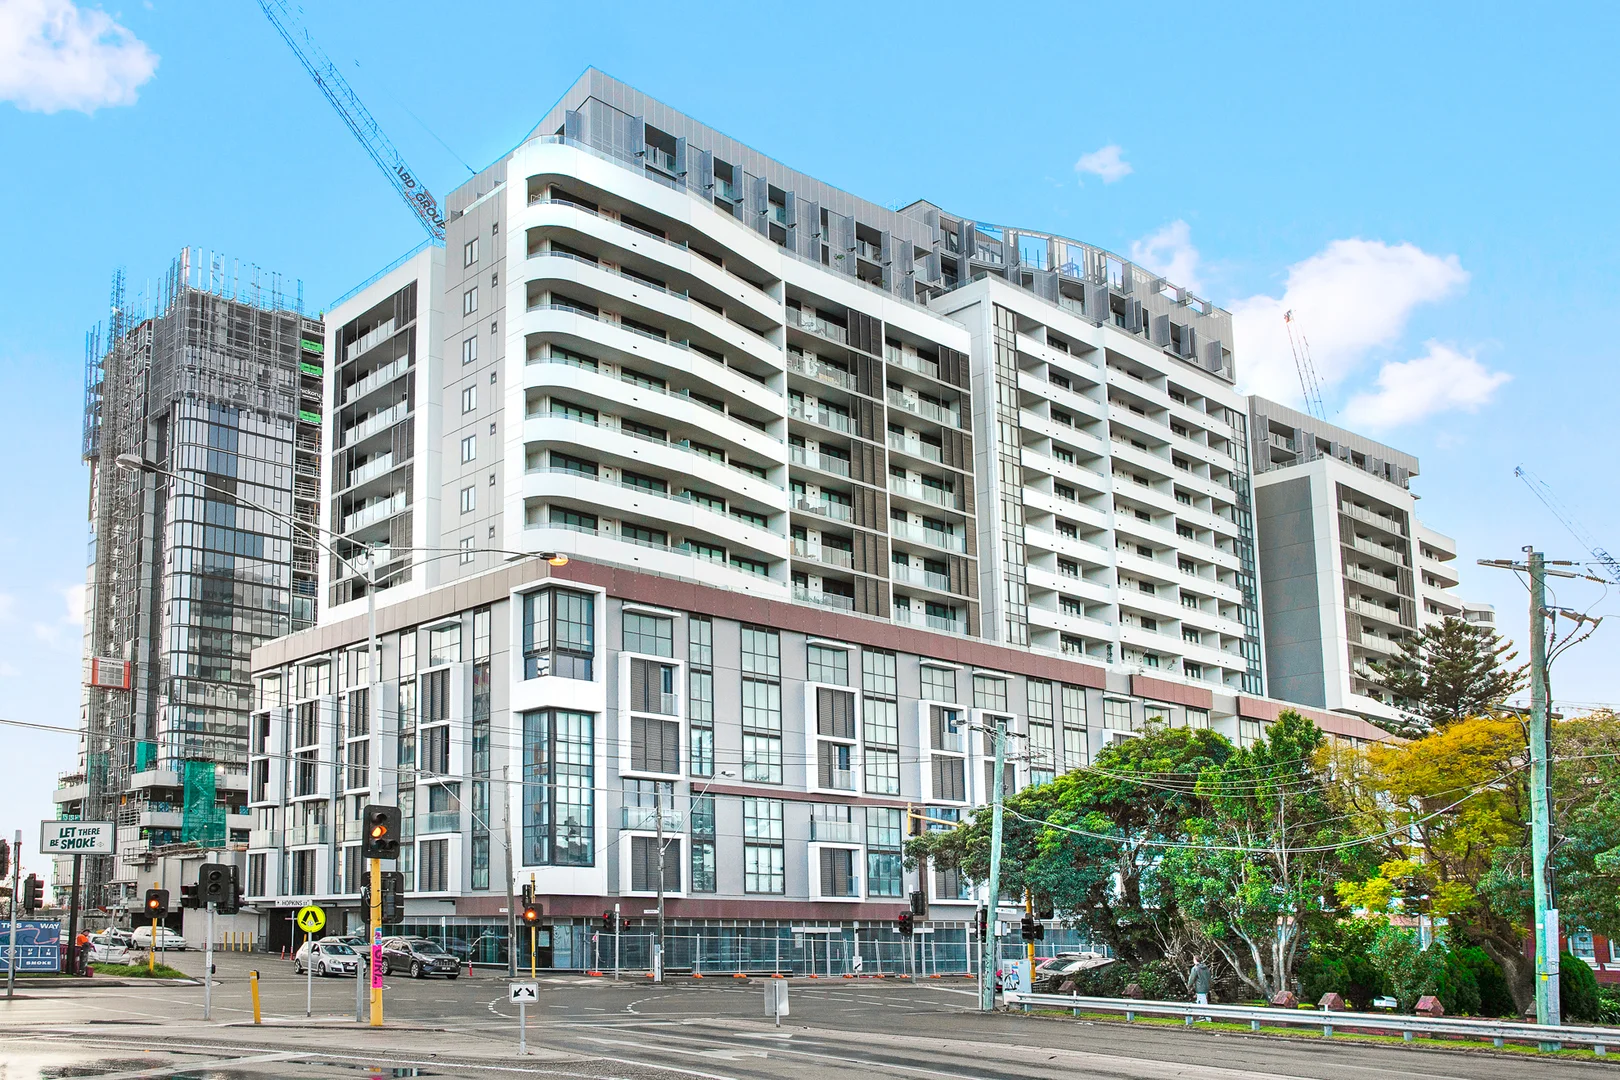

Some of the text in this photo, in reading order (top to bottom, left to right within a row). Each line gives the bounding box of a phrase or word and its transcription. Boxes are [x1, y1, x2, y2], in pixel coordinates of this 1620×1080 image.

[392, 166, 445, 229] ABD GROUP
[59, 827, 100, 838] LET THERE
[49, 837, 96, 849] BE SMOKE
